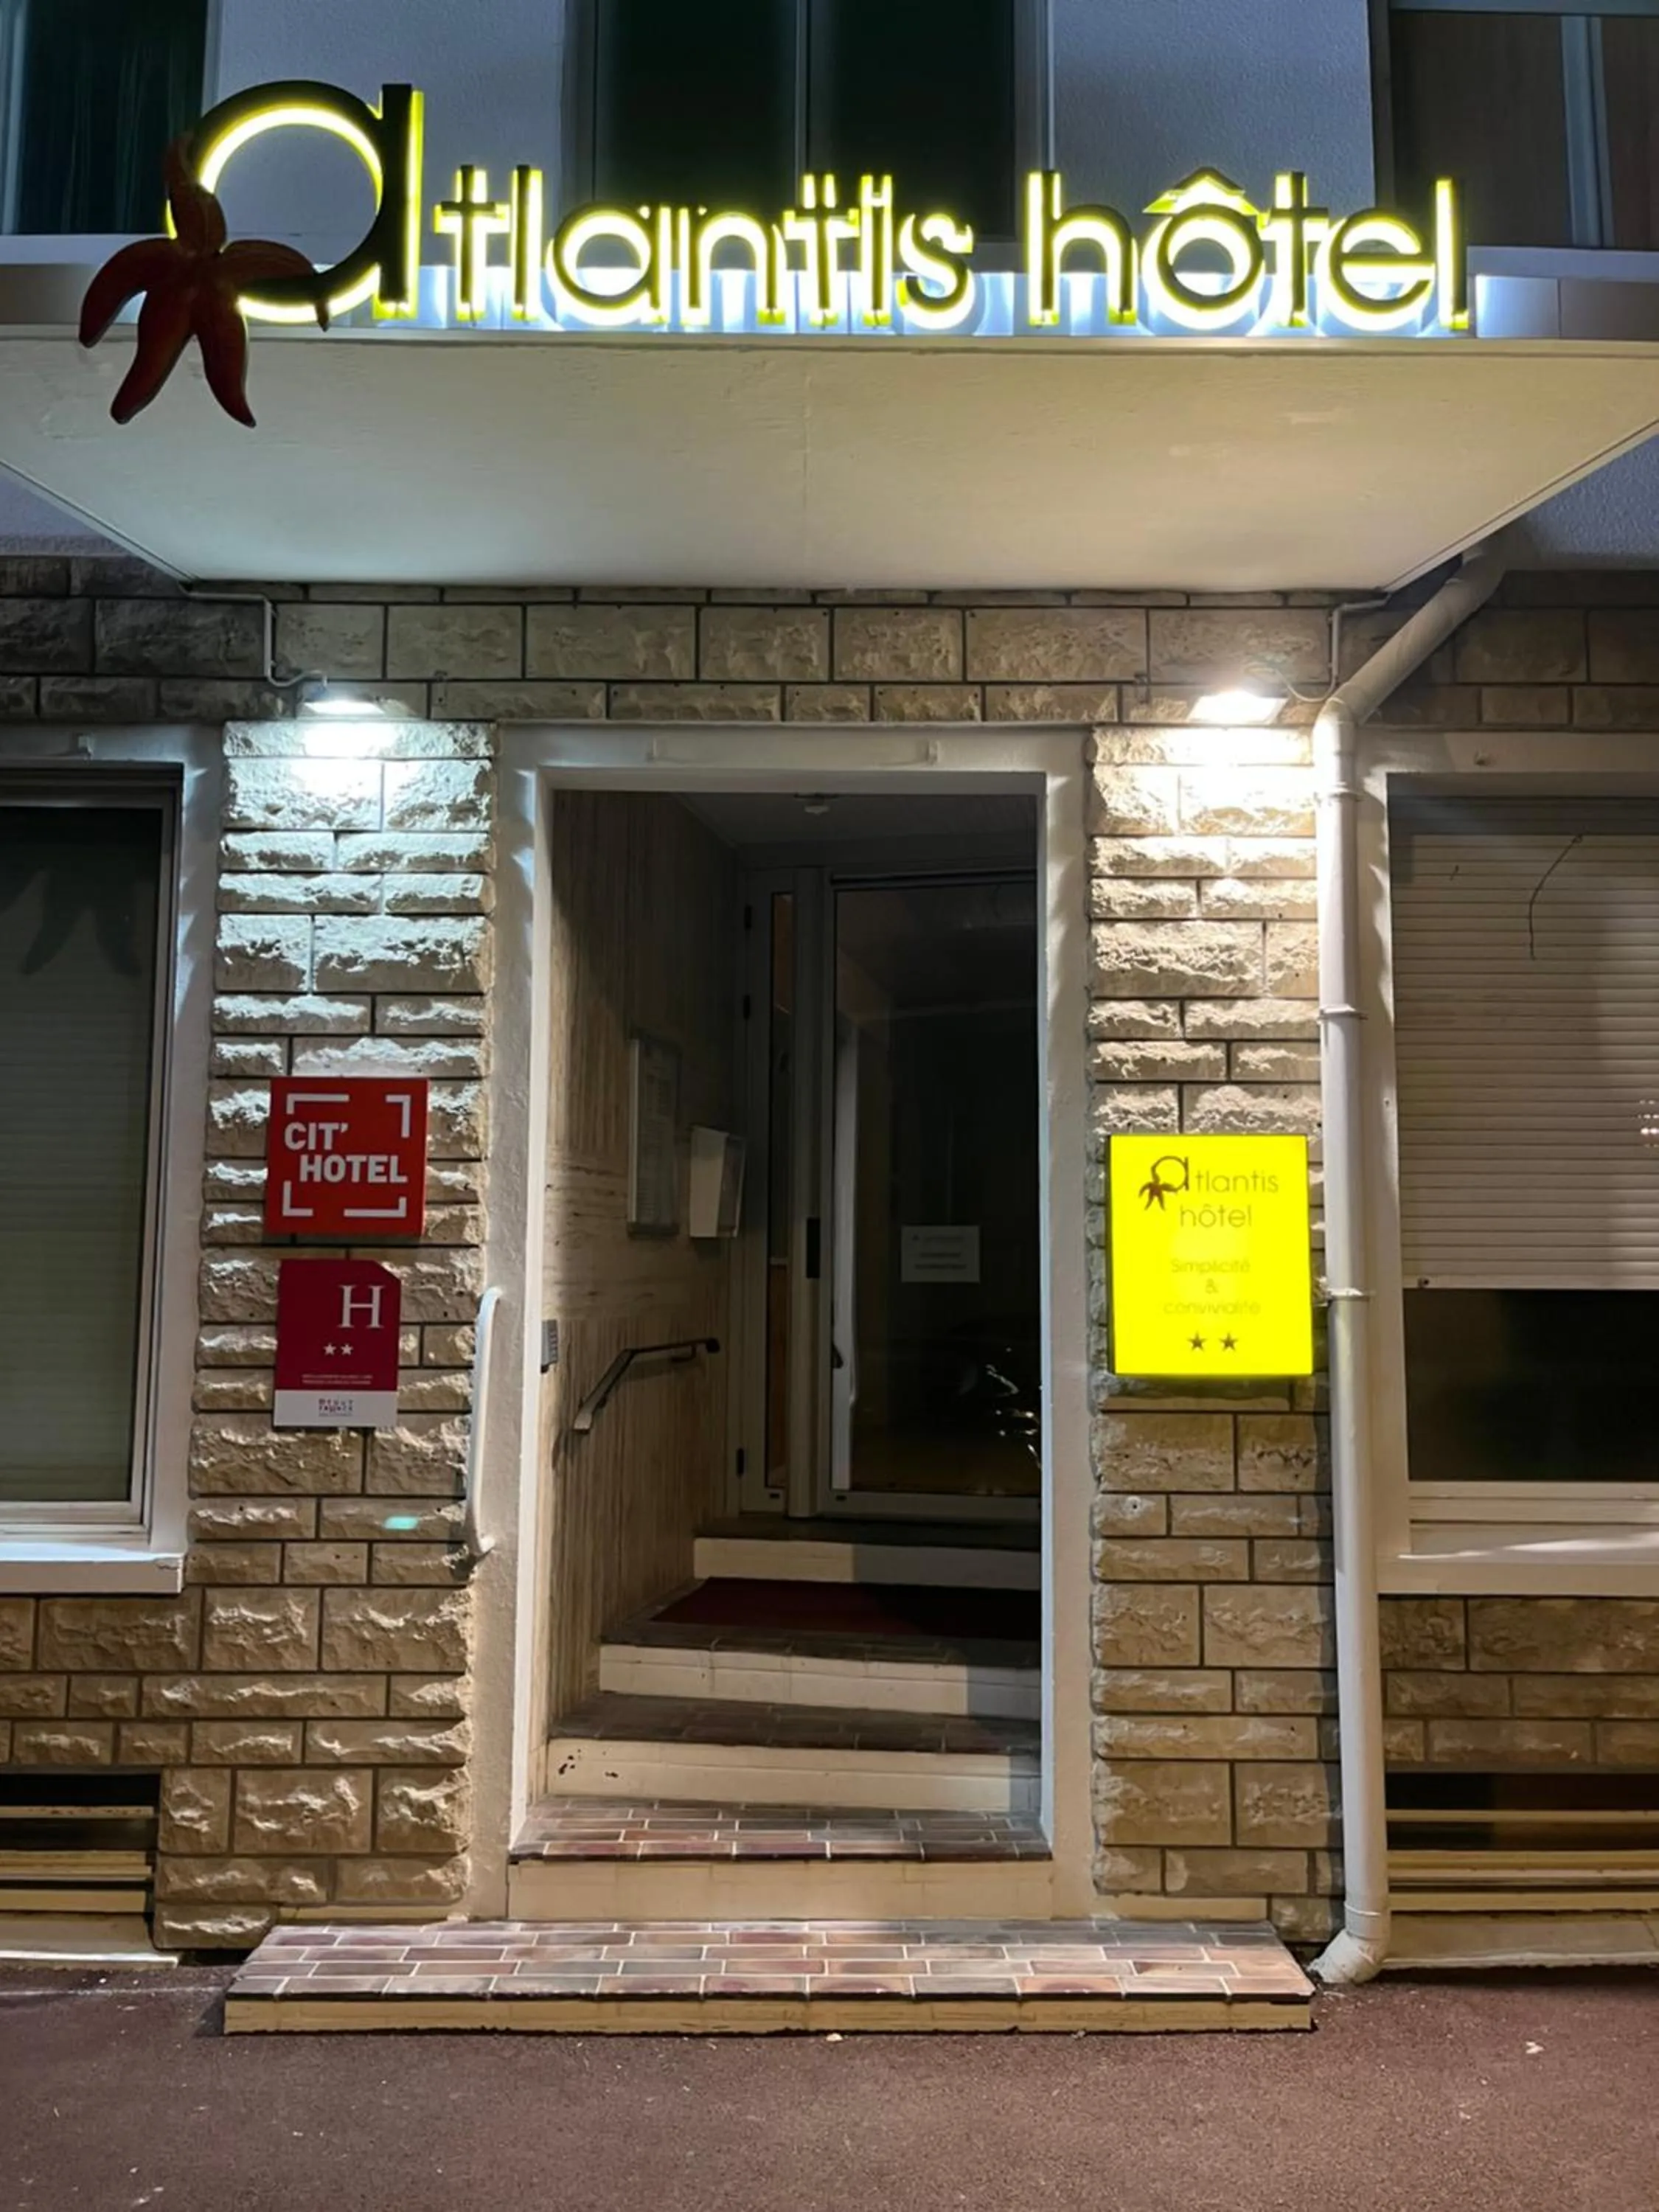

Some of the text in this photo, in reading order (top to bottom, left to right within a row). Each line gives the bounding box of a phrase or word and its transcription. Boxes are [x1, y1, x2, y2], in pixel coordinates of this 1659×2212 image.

[166, 80, 1470, 331] atlantis hôtel
[284, 1121, 349, 1150] CIT'
[299, 1154, 408, 1183] HOTEL
[1151, 1155, 1279, 1193] atlantis
[1180, 1203, 1252, 1228] hôtel
[1205, 1278, 1219, 1294] &
[337, 1284, 386, 1329] H
